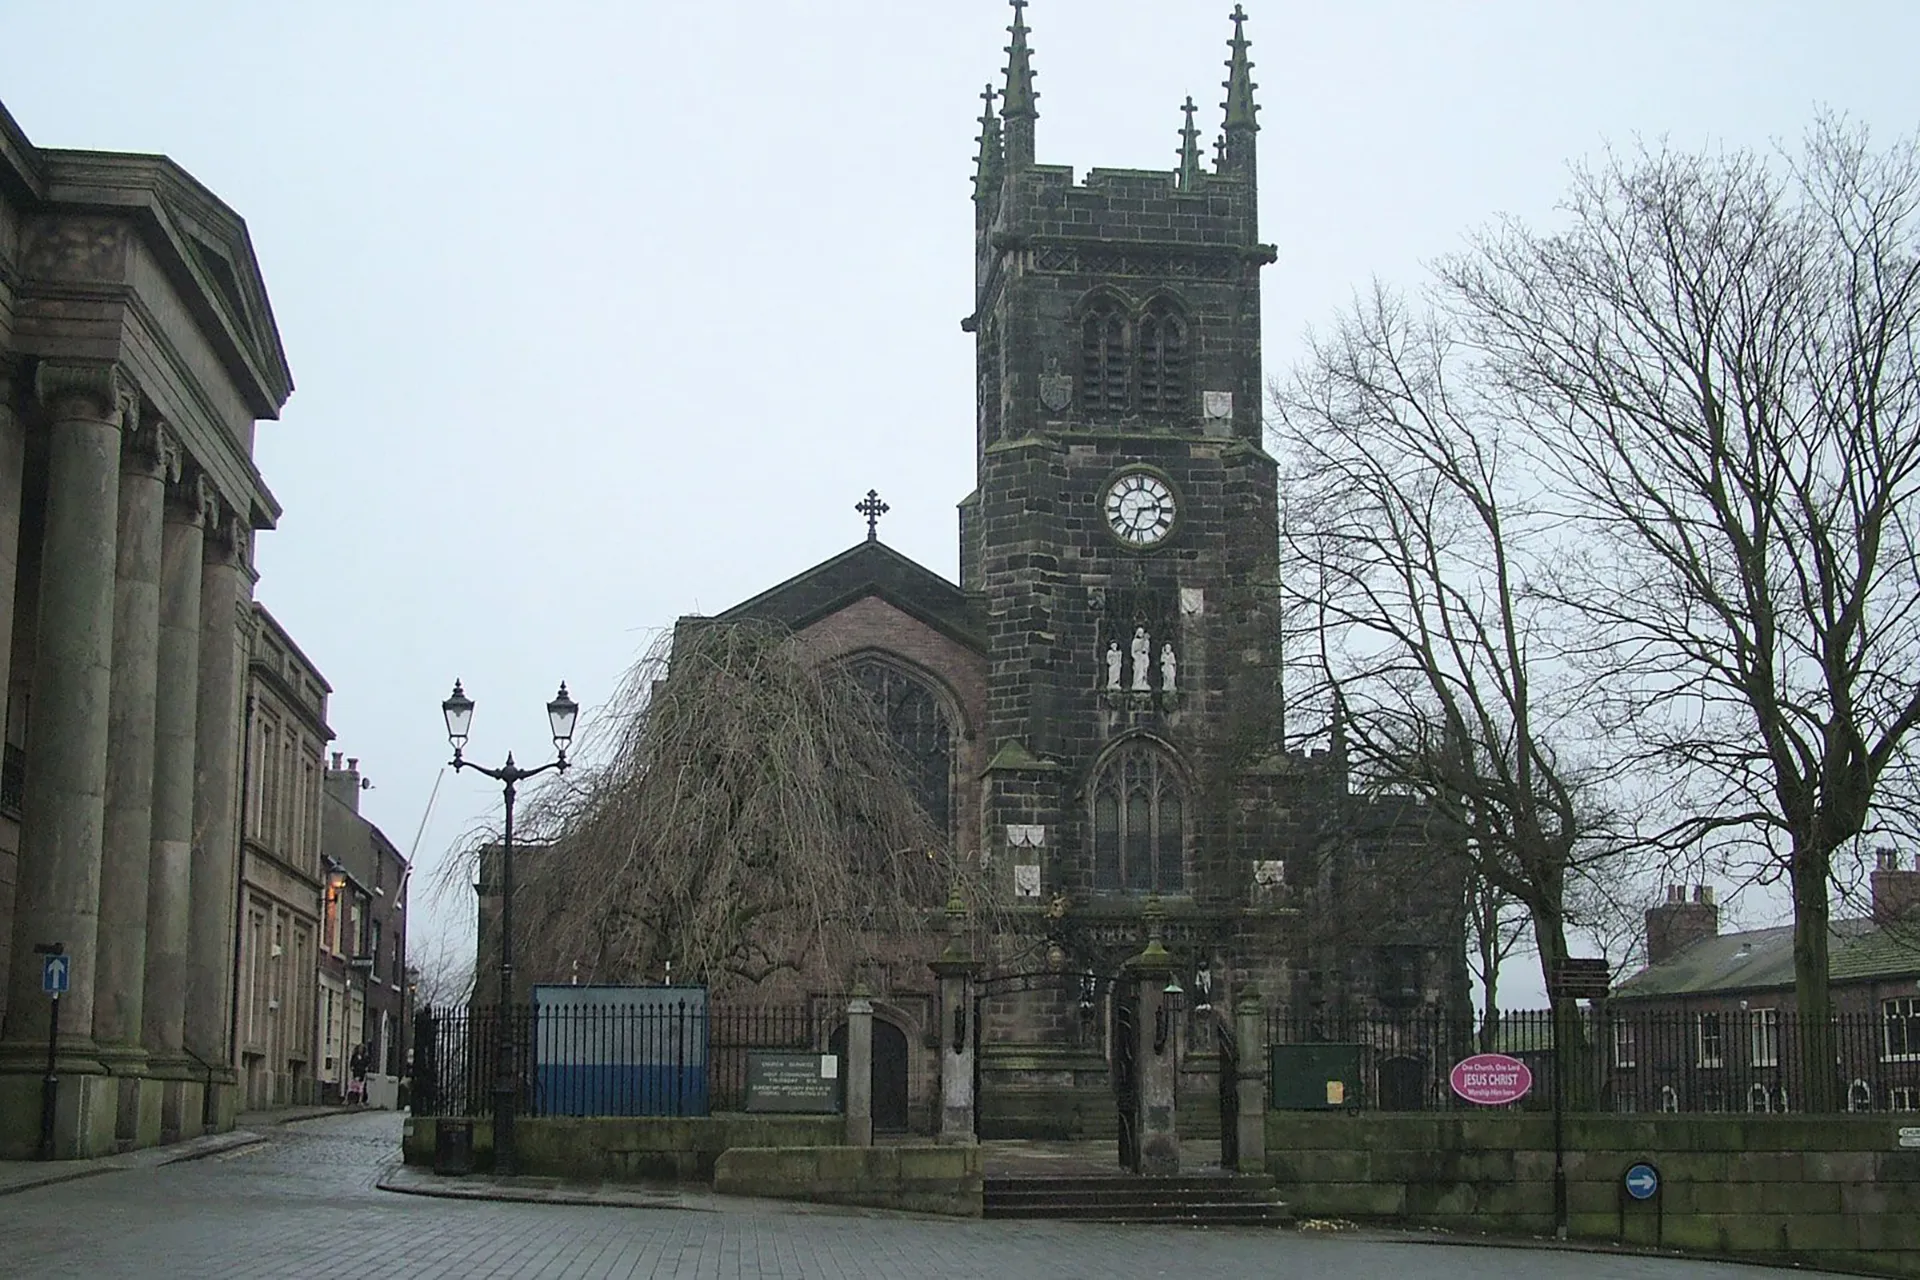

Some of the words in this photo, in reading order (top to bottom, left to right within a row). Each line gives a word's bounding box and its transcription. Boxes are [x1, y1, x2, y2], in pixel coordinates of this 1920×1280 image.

[1461, 1064, 1474, 1072] One
[1463, 1073, 1487, 1088] JESUS
[1489, 1074, 1518, 1086] CHRIST
